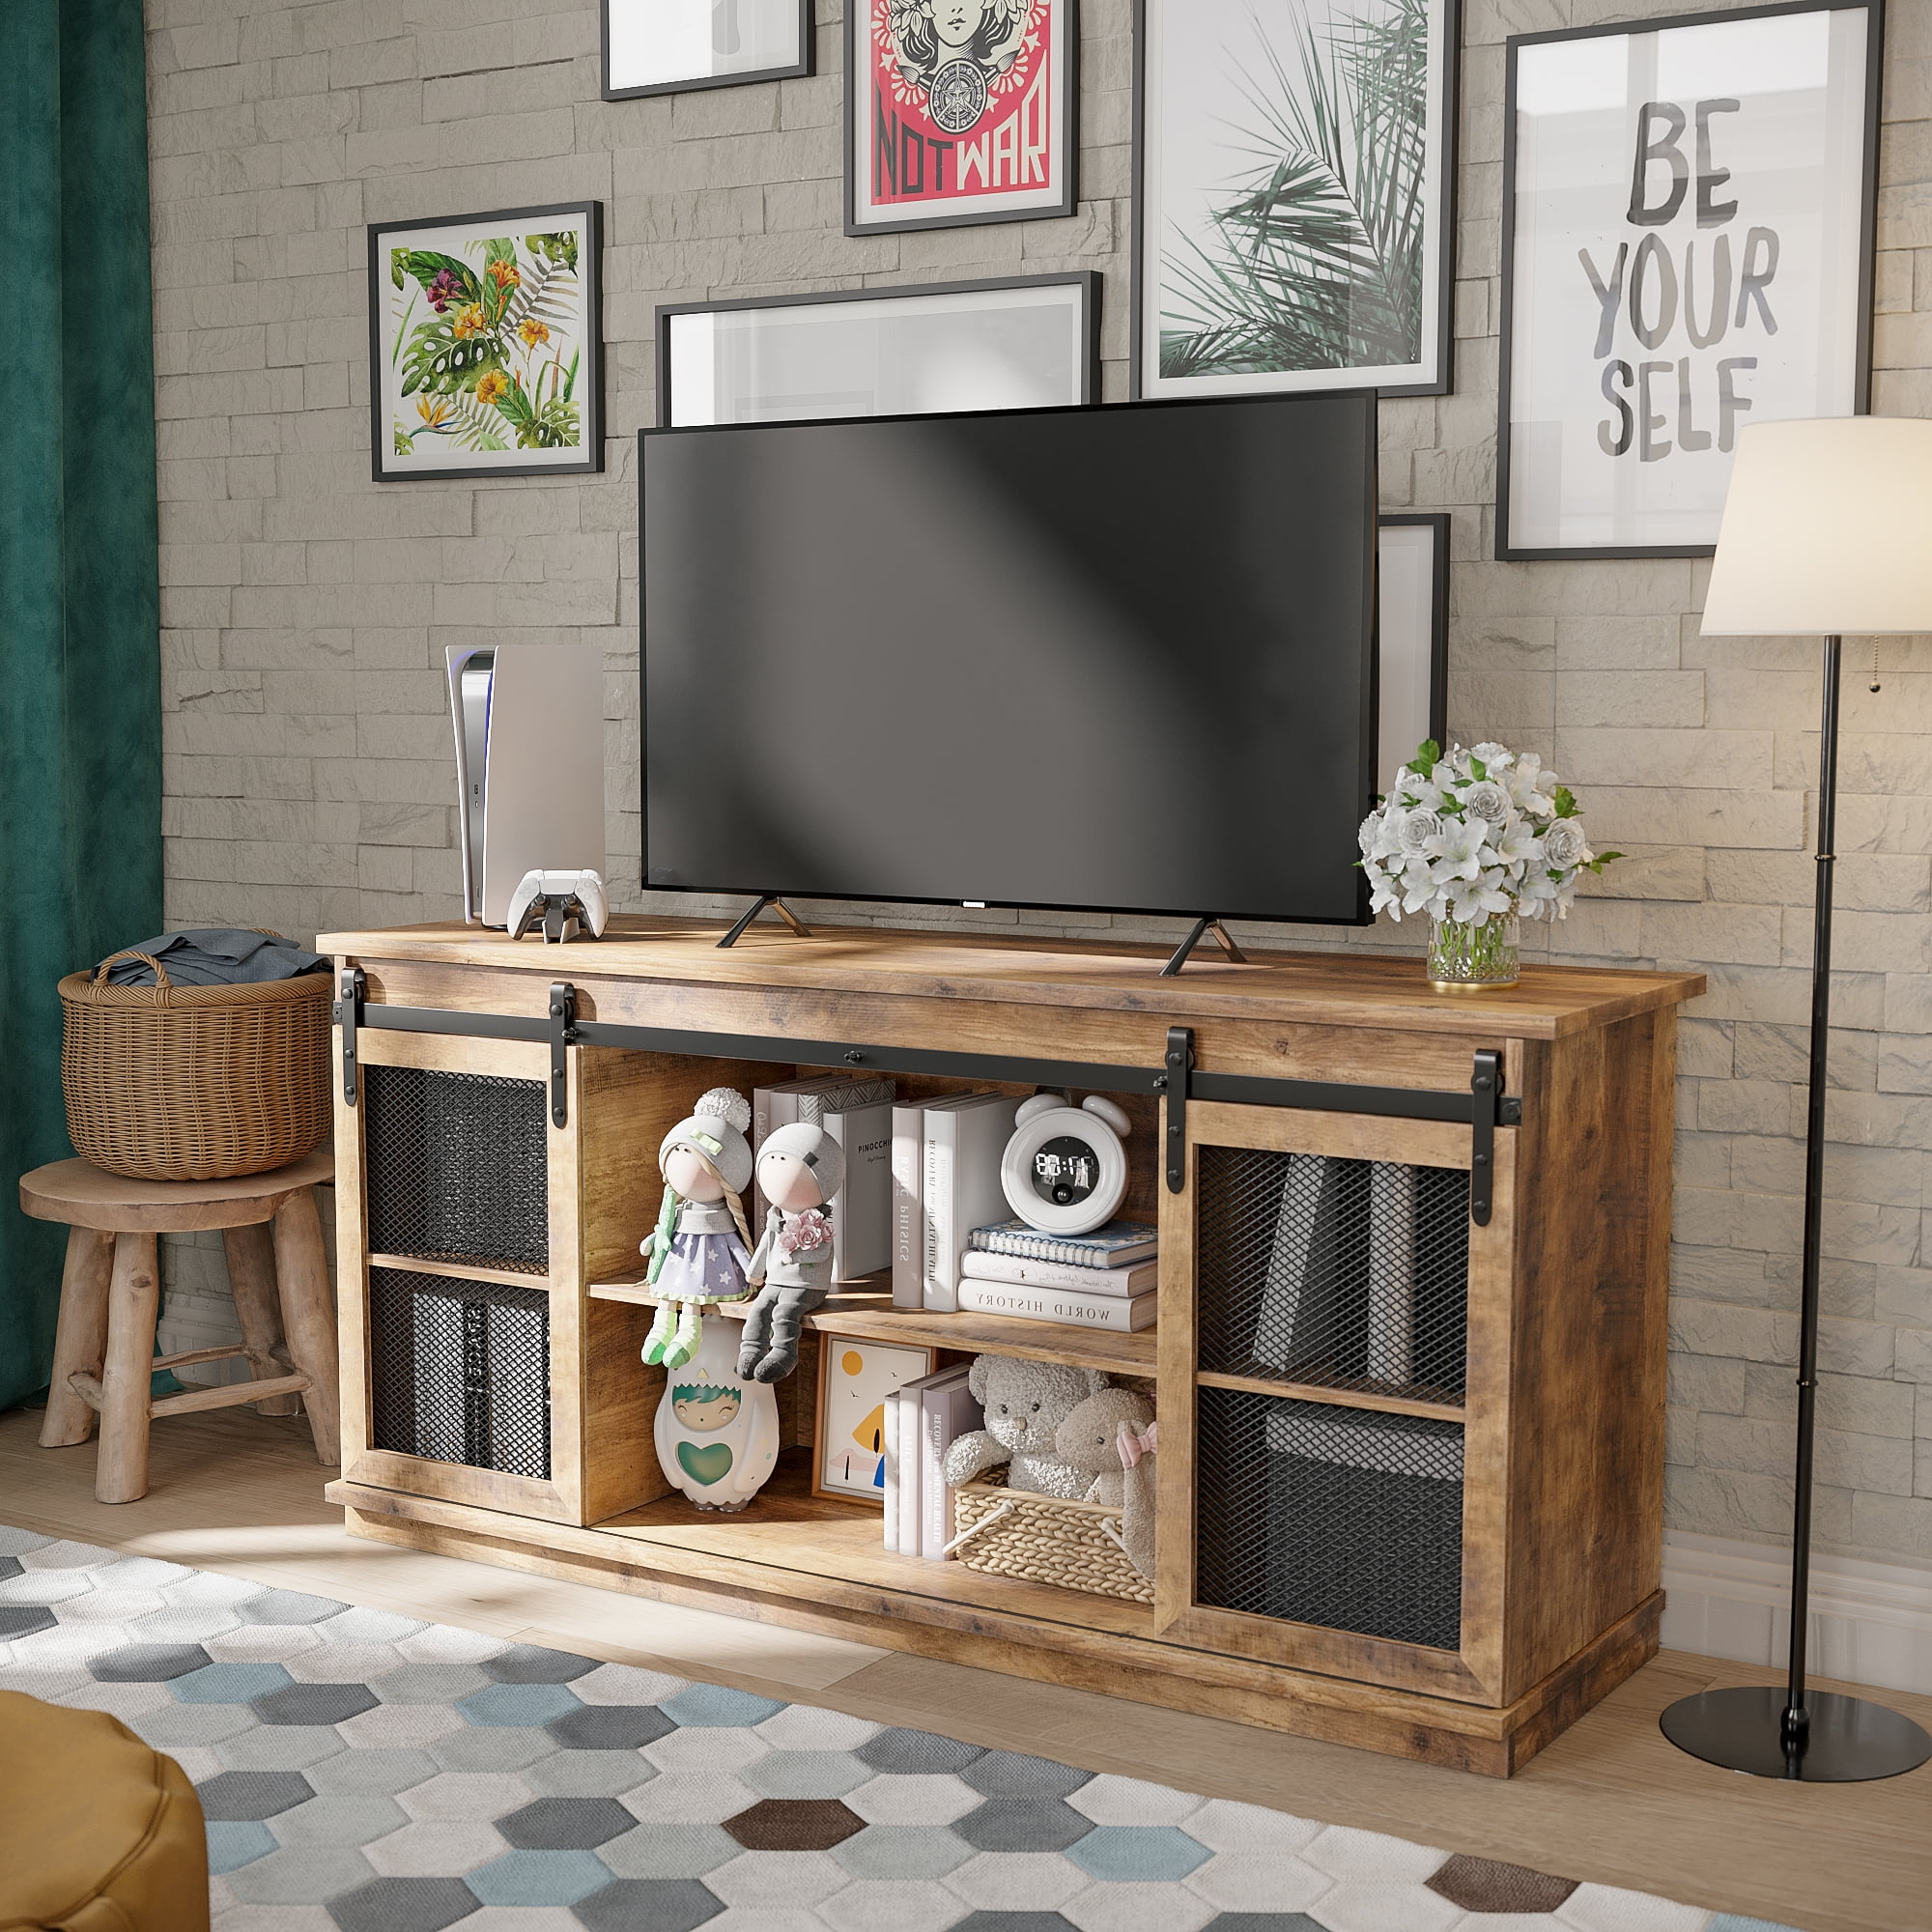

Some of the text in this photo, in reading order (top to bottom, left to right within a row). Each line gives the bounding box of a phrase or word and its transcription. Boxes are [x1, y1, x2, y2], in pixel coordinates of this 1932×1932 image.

[875, 49, 1047, 197] NOT WAR
[1627, 99, 1740, 229] BE
[1577, 226, 1779, 359] YOUR
[1597, 356, 1757, 462] SELF
